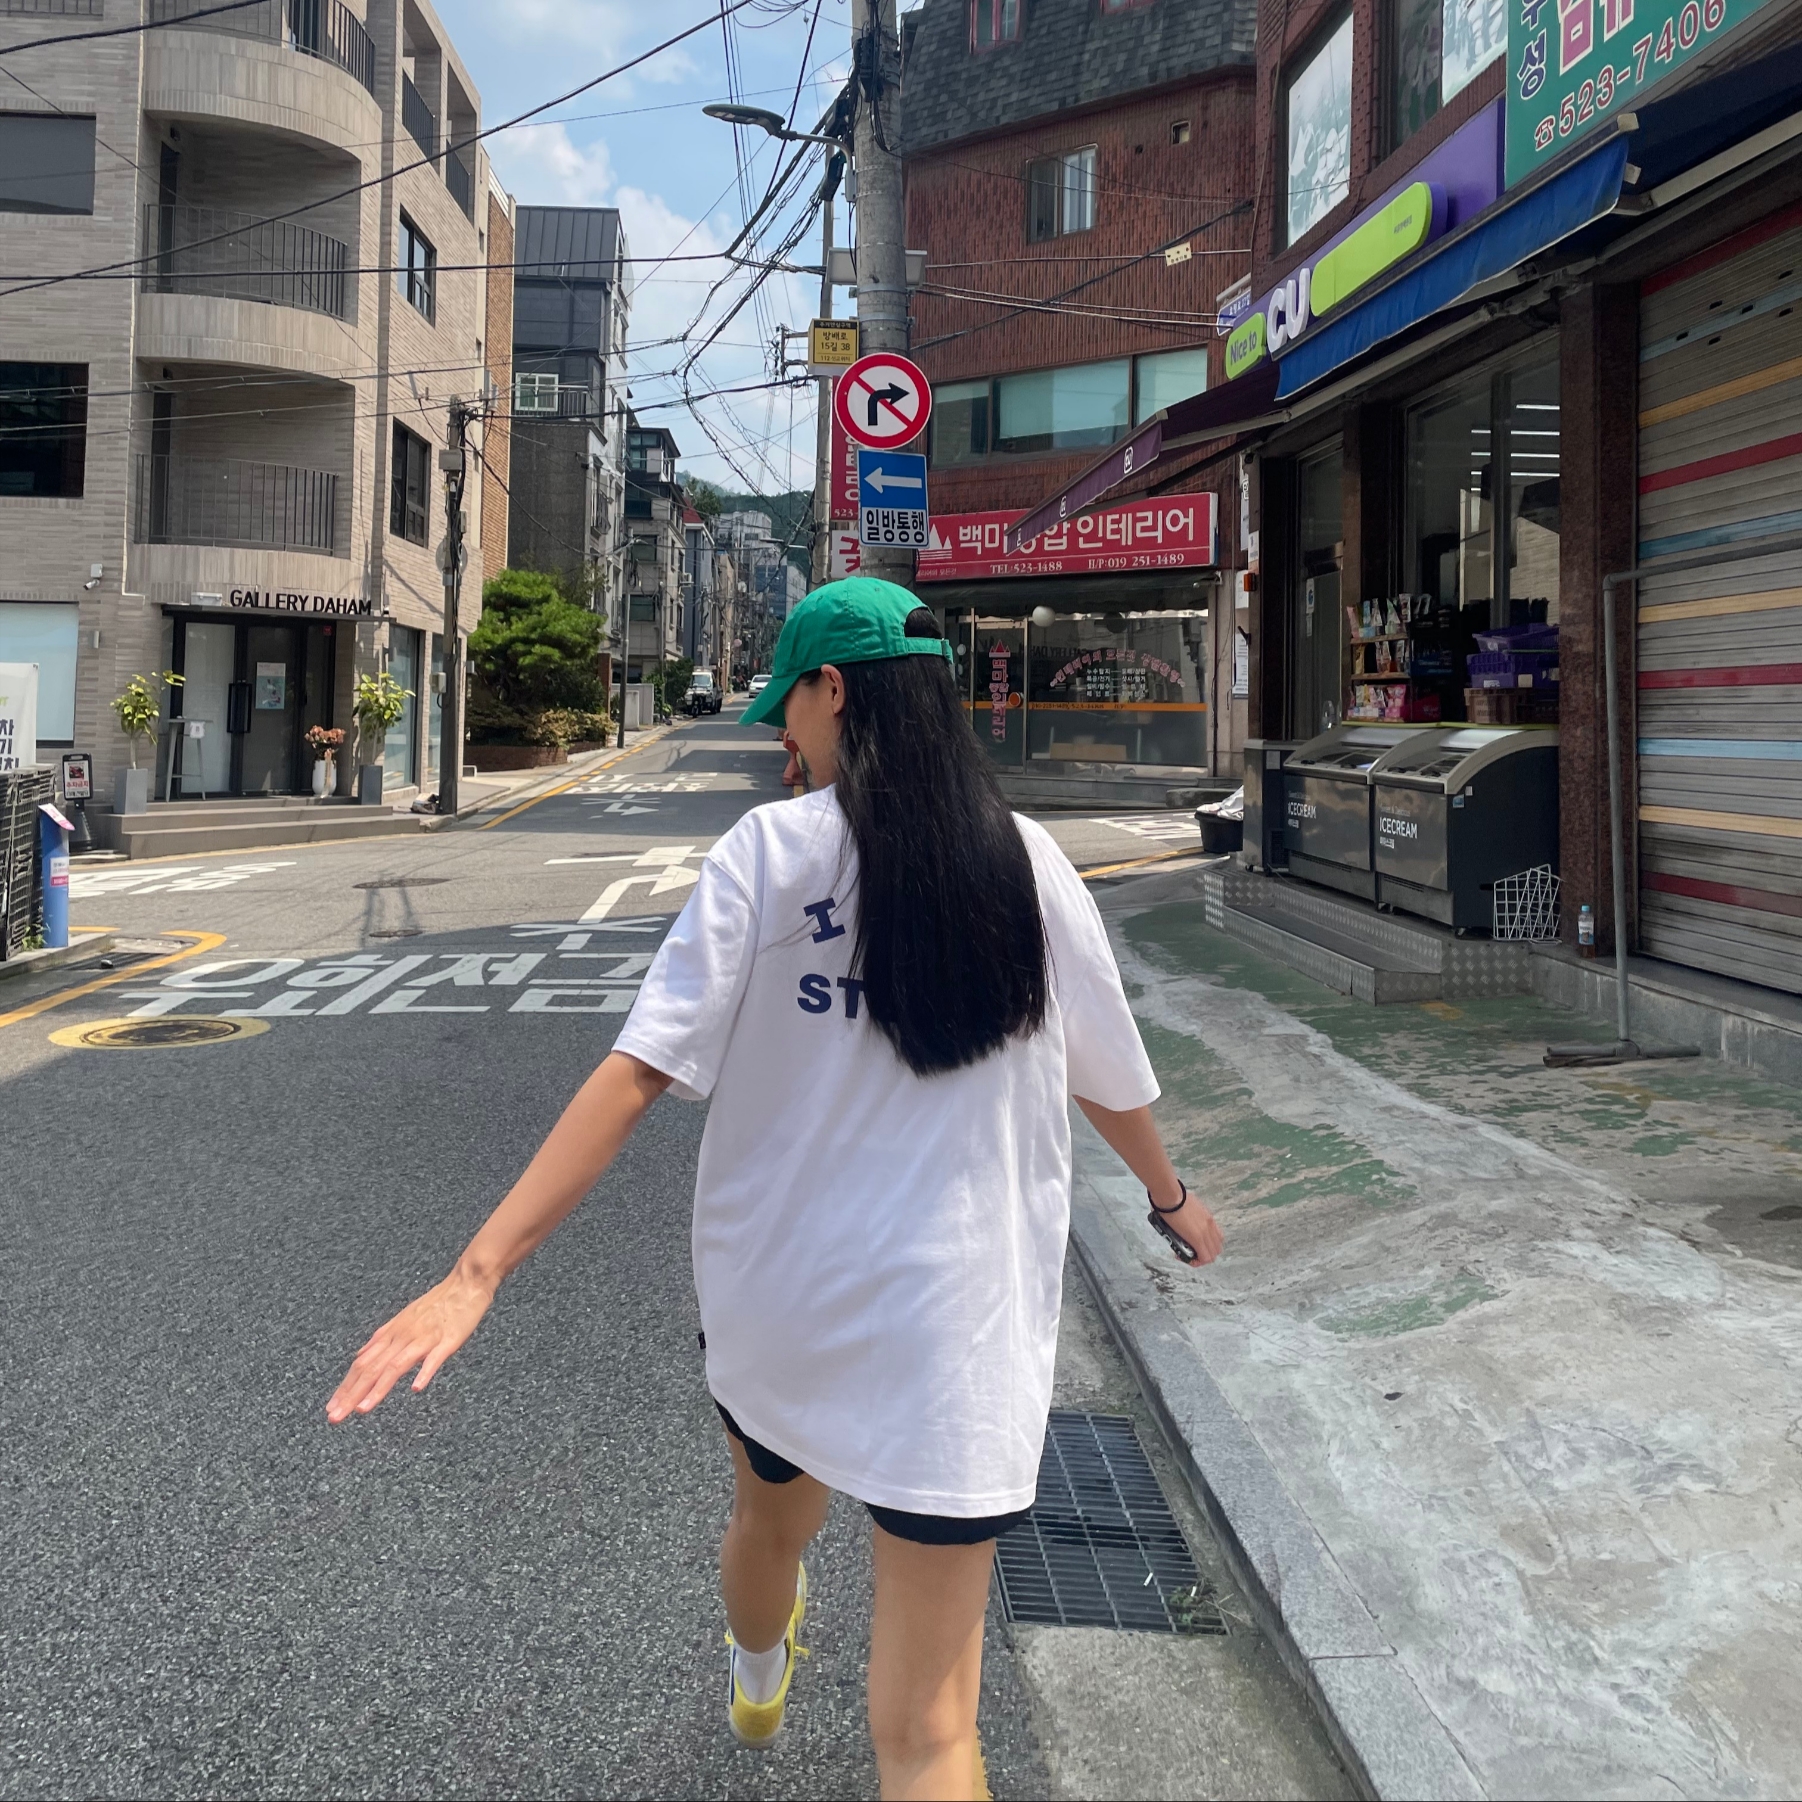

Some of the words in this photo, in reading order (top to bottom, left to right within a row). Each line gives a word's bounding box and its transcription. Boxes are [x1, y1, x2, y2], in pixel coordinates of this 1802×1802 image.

[1558, 0, 1726, 137] 523-7406
[1267, 267, 1311, 353] CU
[820, 341, 838, 352] 15길
[840, 342, 851, 351] 38
[822, 331, 849, 341] 방배로
[1230, 338, 1248, 366] Nice
[1249, 329, 1258, 357] to
[866, 509, 926, 544] 일방통행
[1076, 508, 1194, 549] 인테리어
[1131, 553, 1185, 567] 251-1489
[229, 589, 309, 611] GALLERY
[313, 596, 372, 616] DAHAM
[1287, 802, 1317, 819] ICECREAM
[1379, 817, 1418, 839] ICECREAM
